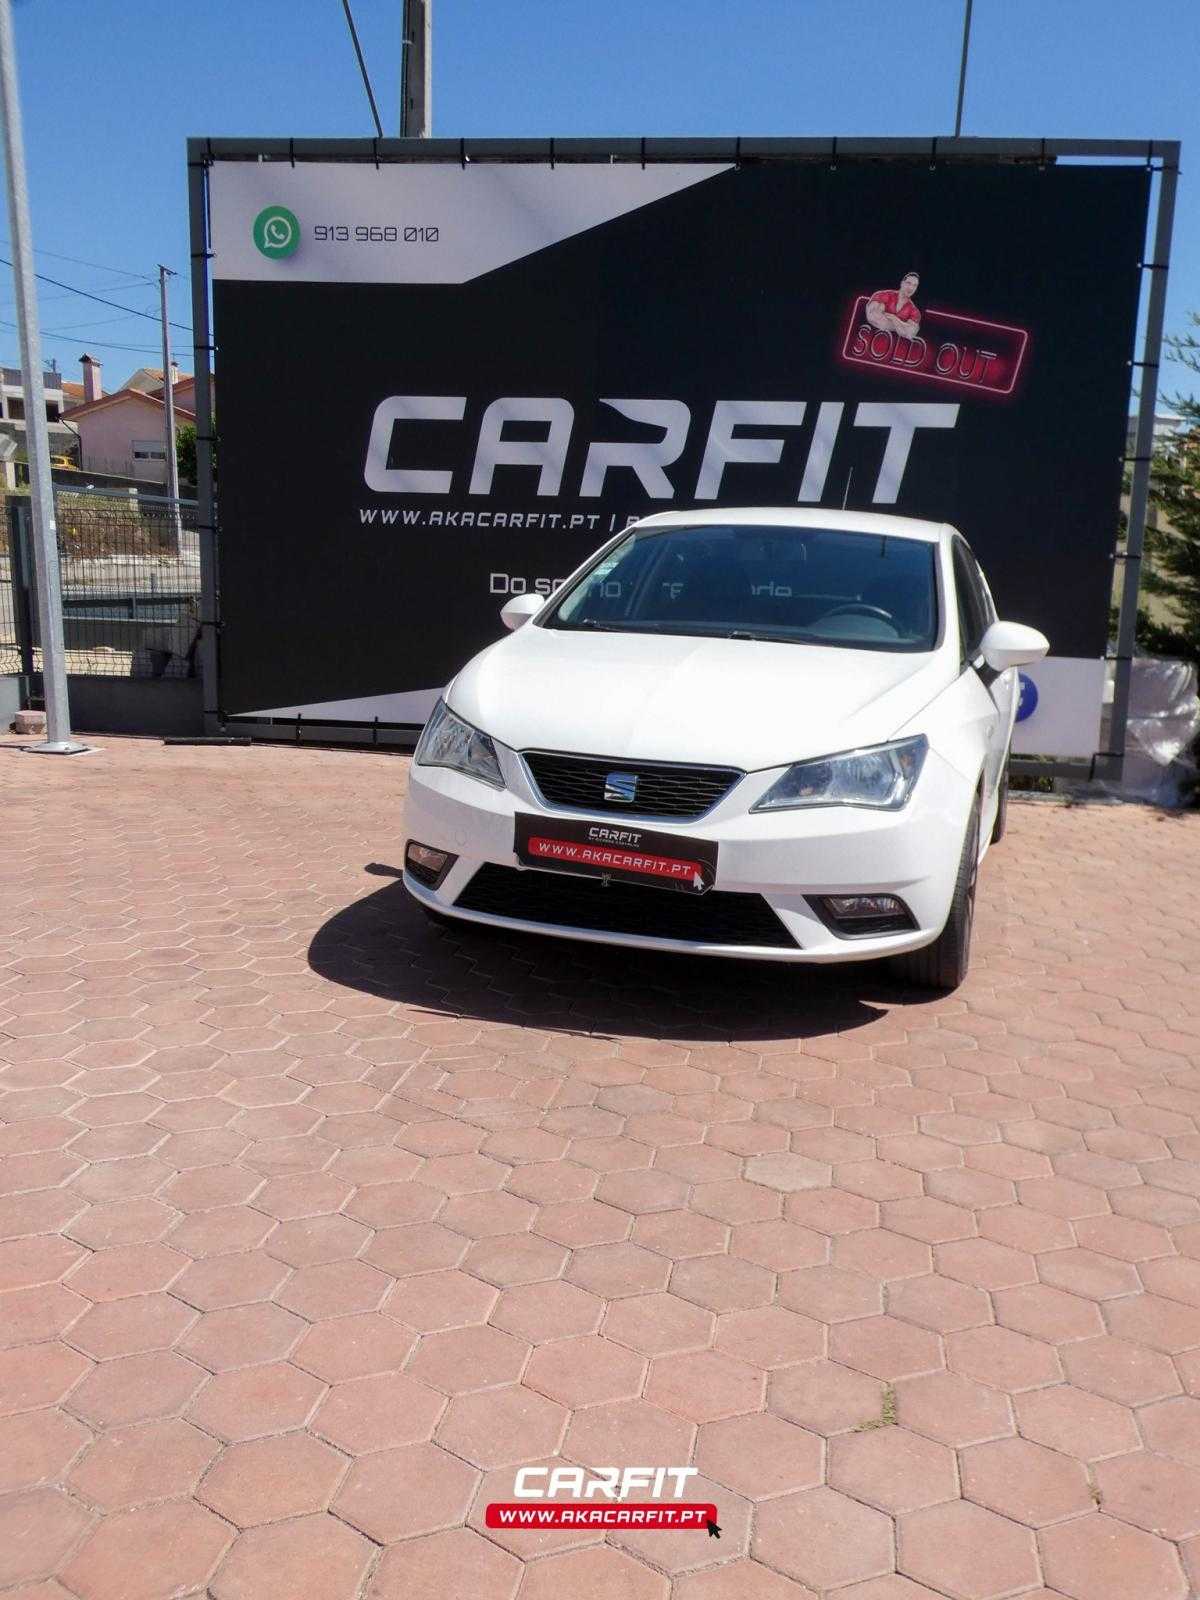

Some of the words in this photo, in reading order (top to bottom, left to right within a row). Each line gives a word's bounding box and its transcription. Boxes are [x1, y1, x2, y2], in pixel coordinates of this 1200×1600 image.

[314, 225, 350, 242] 913
[355, 226, 398, 243] 968
[404, 226, 439, 243] 010
[853, 323, 927, 368] SOLD
[936, 342, 998, 384] OUT
[363, 395, 961, 504] CARFIT
[359, 508, 600, 531] WWW.AKACARFIT.PT
[489, 572, 527, 595] Do
[588, 826, 642, 844] CARFIT
[538, 841, 692, 876] WWW.AKACARFIT.PT
